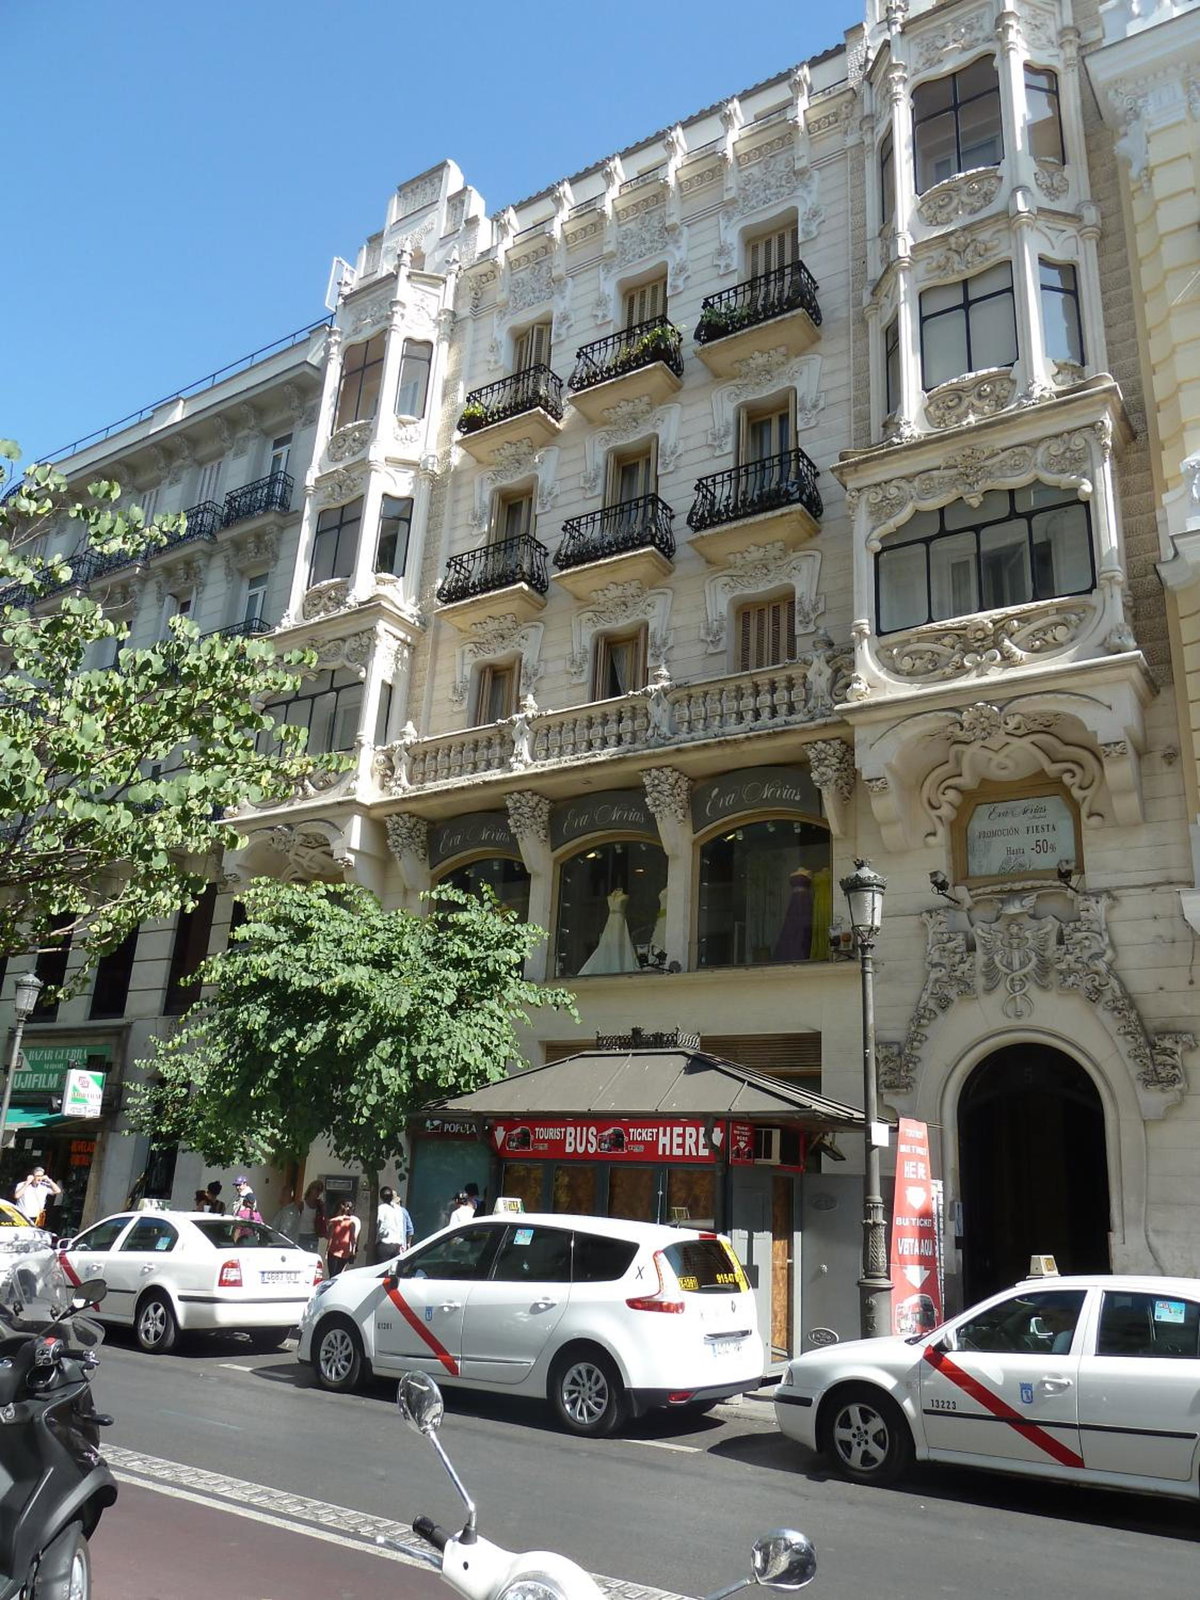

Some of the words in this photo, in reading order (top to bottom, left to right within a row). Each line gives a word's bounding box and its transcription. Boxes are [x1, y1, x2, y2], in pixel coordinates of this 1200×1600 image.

[705, 786, 739, 817] Eva
[742, 779, 801, 804] Novias
[562, 808, 591, 835] Eva
[978, 826, 1019, 840] PROMOCIÓN
[1026, 824, 1056, 835] FIESTA
[1006, 847, 1025, 856] Hasta
[13, 1073, 58, 1089] UJIFILM
[534, 1127, 566, 1140] TOURIST
[564, 1126, 597, 1154] BUS
[628, 1127, 658, 1141] TICKET
[657, 1126, 709, 1156] HERE
[930, 1399, 957, 1410] 13223
